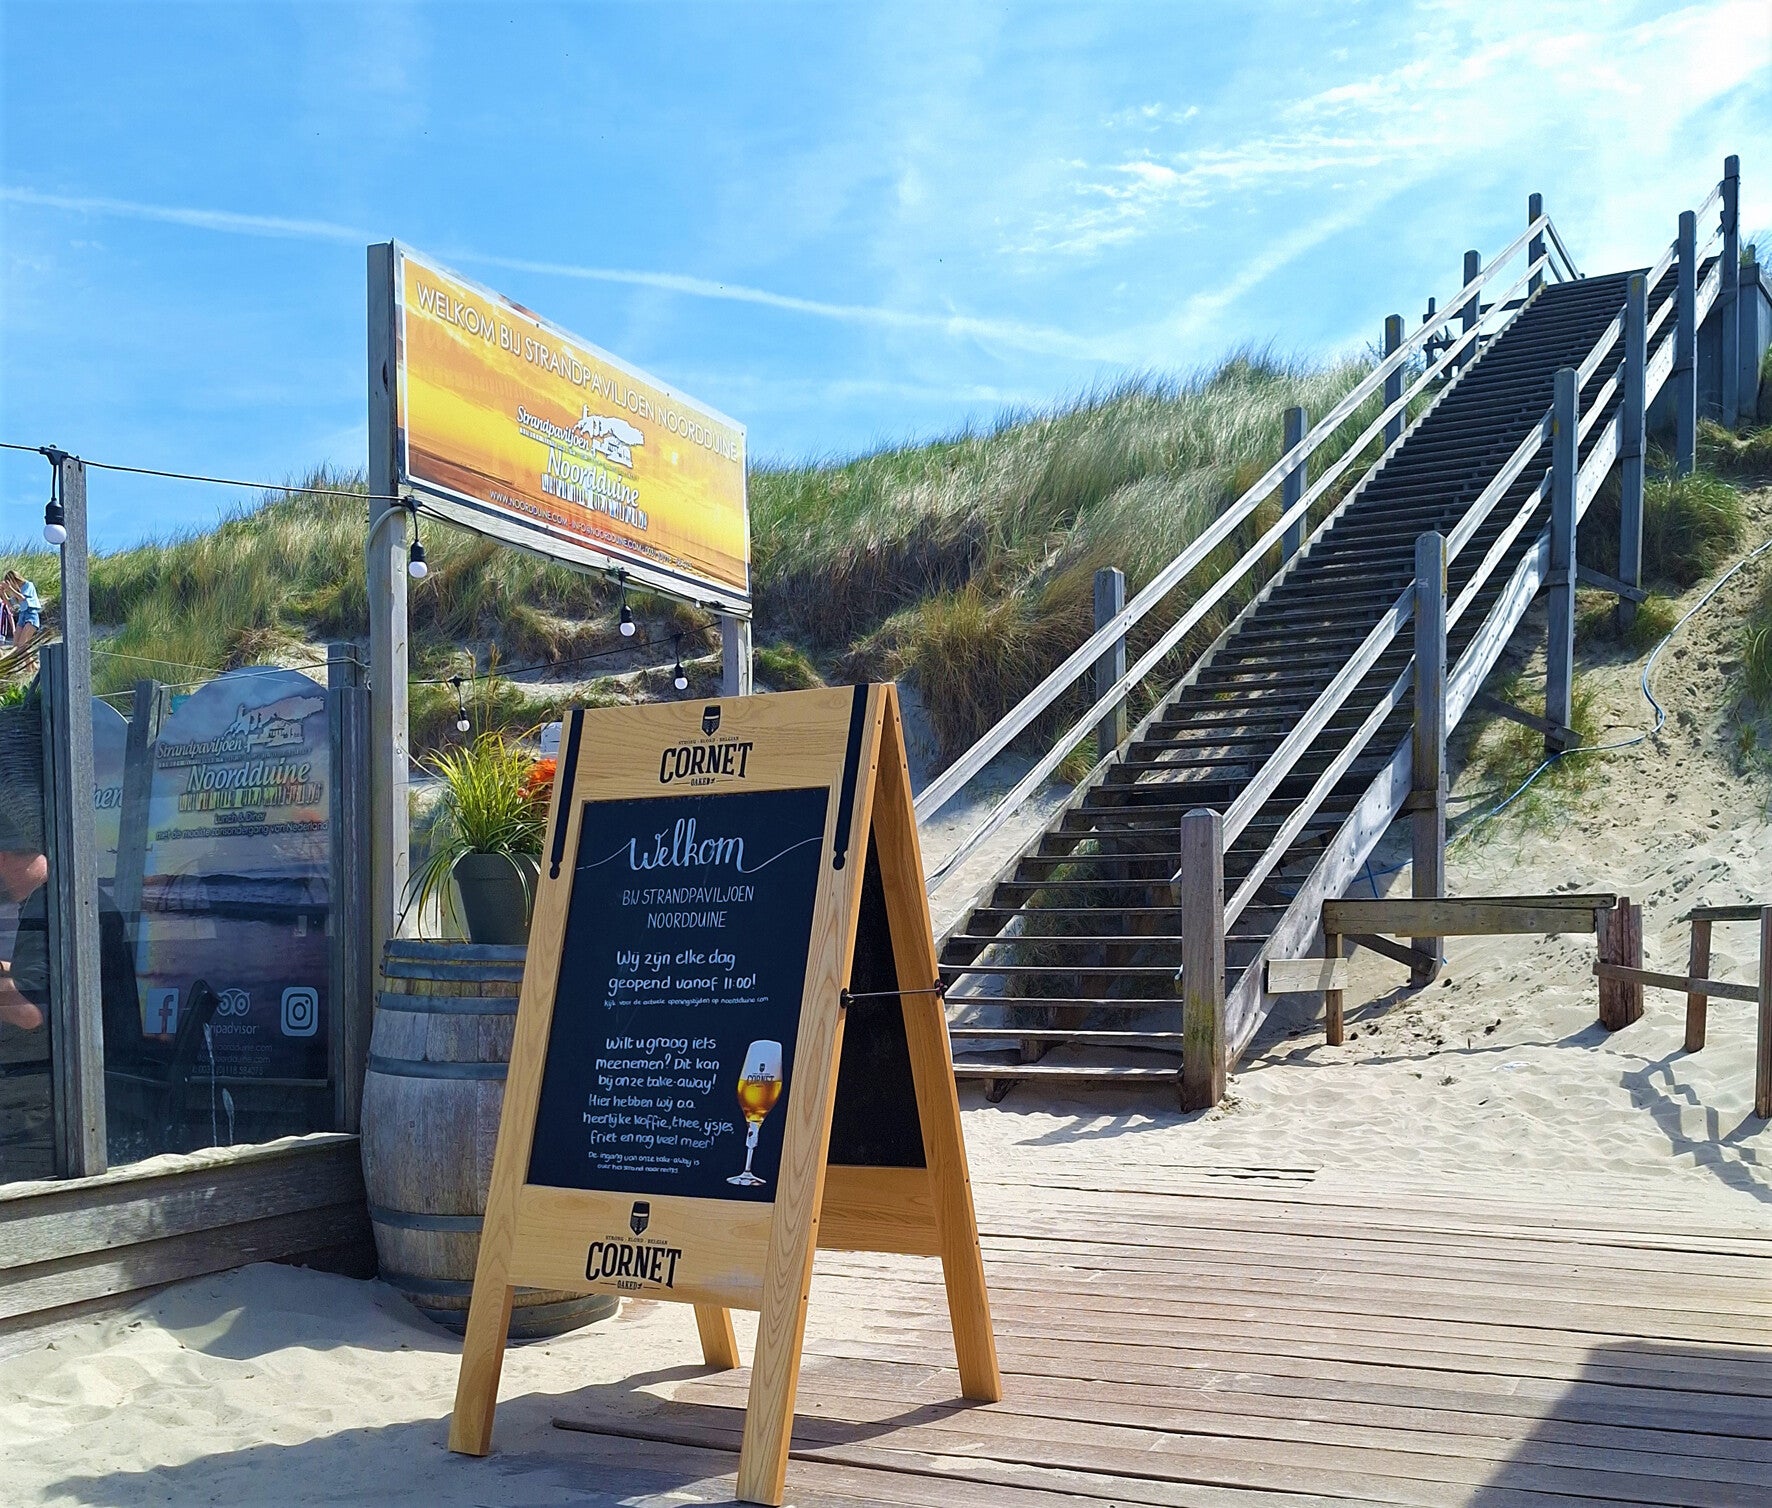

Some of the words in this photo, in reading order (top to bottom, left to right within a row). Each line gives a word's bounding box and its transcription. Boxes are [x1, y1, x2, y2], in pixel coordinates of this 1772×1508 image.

[416, 281, 496, 345] WELKOM
[500, 324, 522, 356] BIJ
[524, 336, 656, 423] STRANDPAVILJOEN
[658, 406, 739, 463] NOORDDUINE
[516, 405, 589, 451] Strandpaviljoen
[547, 446, 640, 508] Noordduine
[489, 489, 568, 526] WWW.NOORDDUINE.COM
[156, 737, 245, 760] Strandpaviljoen
[659, 742, 754, 784] CORNET
[188, 757, 312, 792] Noordduine
[690, 778, 711, 787] OAKED
[214, 814, 237, 825] Lunch
[246, 811, 267, 823] Diner
[271, 823, 287, 833] van
[287, 820, 329, 833] Nederland
[629, 817, 746, 874] Welkom
[622, 889, 640, 906] BIJ
[641, 885, 755, 905] STRANDPAVILJOEN
[647, 911, 728, 929] NOORDDUINE
[675, 949, 706, 965] elke
[708, 949, 736, 971] dag
[608, 976, 671, 996] geopend
[675, 977, 718, 991] vanaf
[724, 973, 756, 990] 11:00!
[206, 1022, 257, 1036] ripadvisor
[606, 1037, 633, 1050] Wilt
[635, 1041, 645, 1049] u
[645, 1038, 688, 1055] graag
[692, 1037, 717, 1050] iets
[595, 1053, 672, 1071] meenemen?
[673, 1058, 692, 1071] Dit
[695, 1058, 720, 1070] kan
[614, 1077, 644, 1088] onze
[646, 1073, 717, 1095] take-away!
[588, 1093, 613, 1107] Hier
[613, 1096, 653, 1108] hebben
[633, 1114, 672, 1131] koffie,
[672, 1116, 702, 1132] thee,
[590, 1130, 617, 1144] friet
[619, 1134, 634, 1143] en
[635, 1135, 655, 1149] nog
[656, 1135, 679, 1145] veel
[680, 1136, 715, 1149] meer!
[600, 1152, 623, 1163] ingang
[638, 1155, 655, 1163] onze
[585, 1241, 682, 1289] CORNET
[616, 1280, 638, 1290] OAKED
